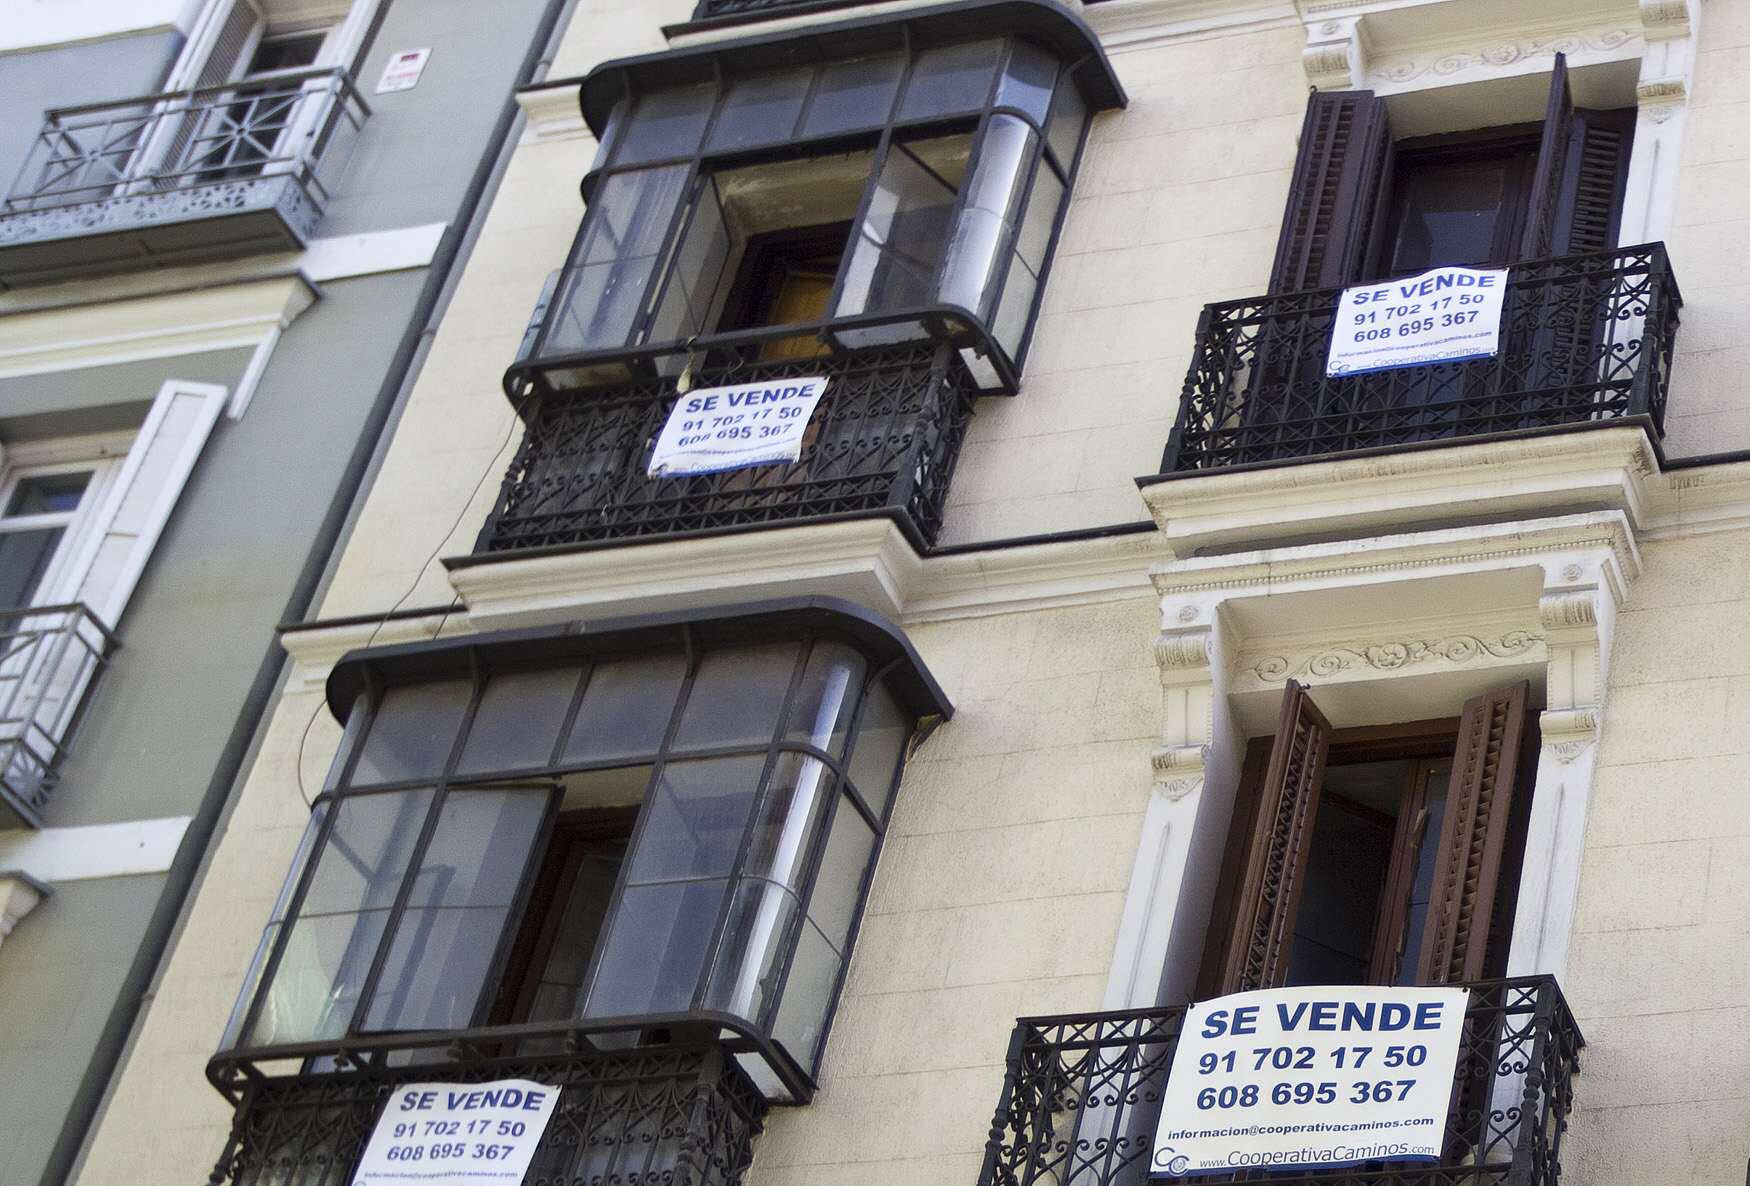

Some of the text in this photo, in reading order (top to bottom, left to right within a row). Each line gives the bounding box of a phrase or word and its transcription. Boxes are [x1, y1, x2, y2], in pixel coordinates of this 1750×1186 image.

[1353, 274, 1496, 305] SE VENDE
[1354, 295, 1484, 325] 91 702 17 50
[1354, 311, 1479, 342] 608 695 367
[686, 383, 816, 413] SE VENDE
[682, 407, 802, 432] 91 702 17 50
[717, 426, 751, 439] 695
[758, 423, 793, 438] 367
[1201, 1001, 1444, 1039] SE VENDE
[1198, 1045, 1428, 1075] 91 702 17 50
[400, 1088, 546, 1112] SE VENDE
[1196, 1079, 1417, 1110] 608 695 367
[393, 1120, 526, 1138] 91 702 17 50
[1168, 1116, 1434, 1140] informacion@cooperativacaminos.com
[387, 1143, 514, 1161] 608 695 367
[1200, 1142, 1435, 1168] www.CooperativaCaminos.com
